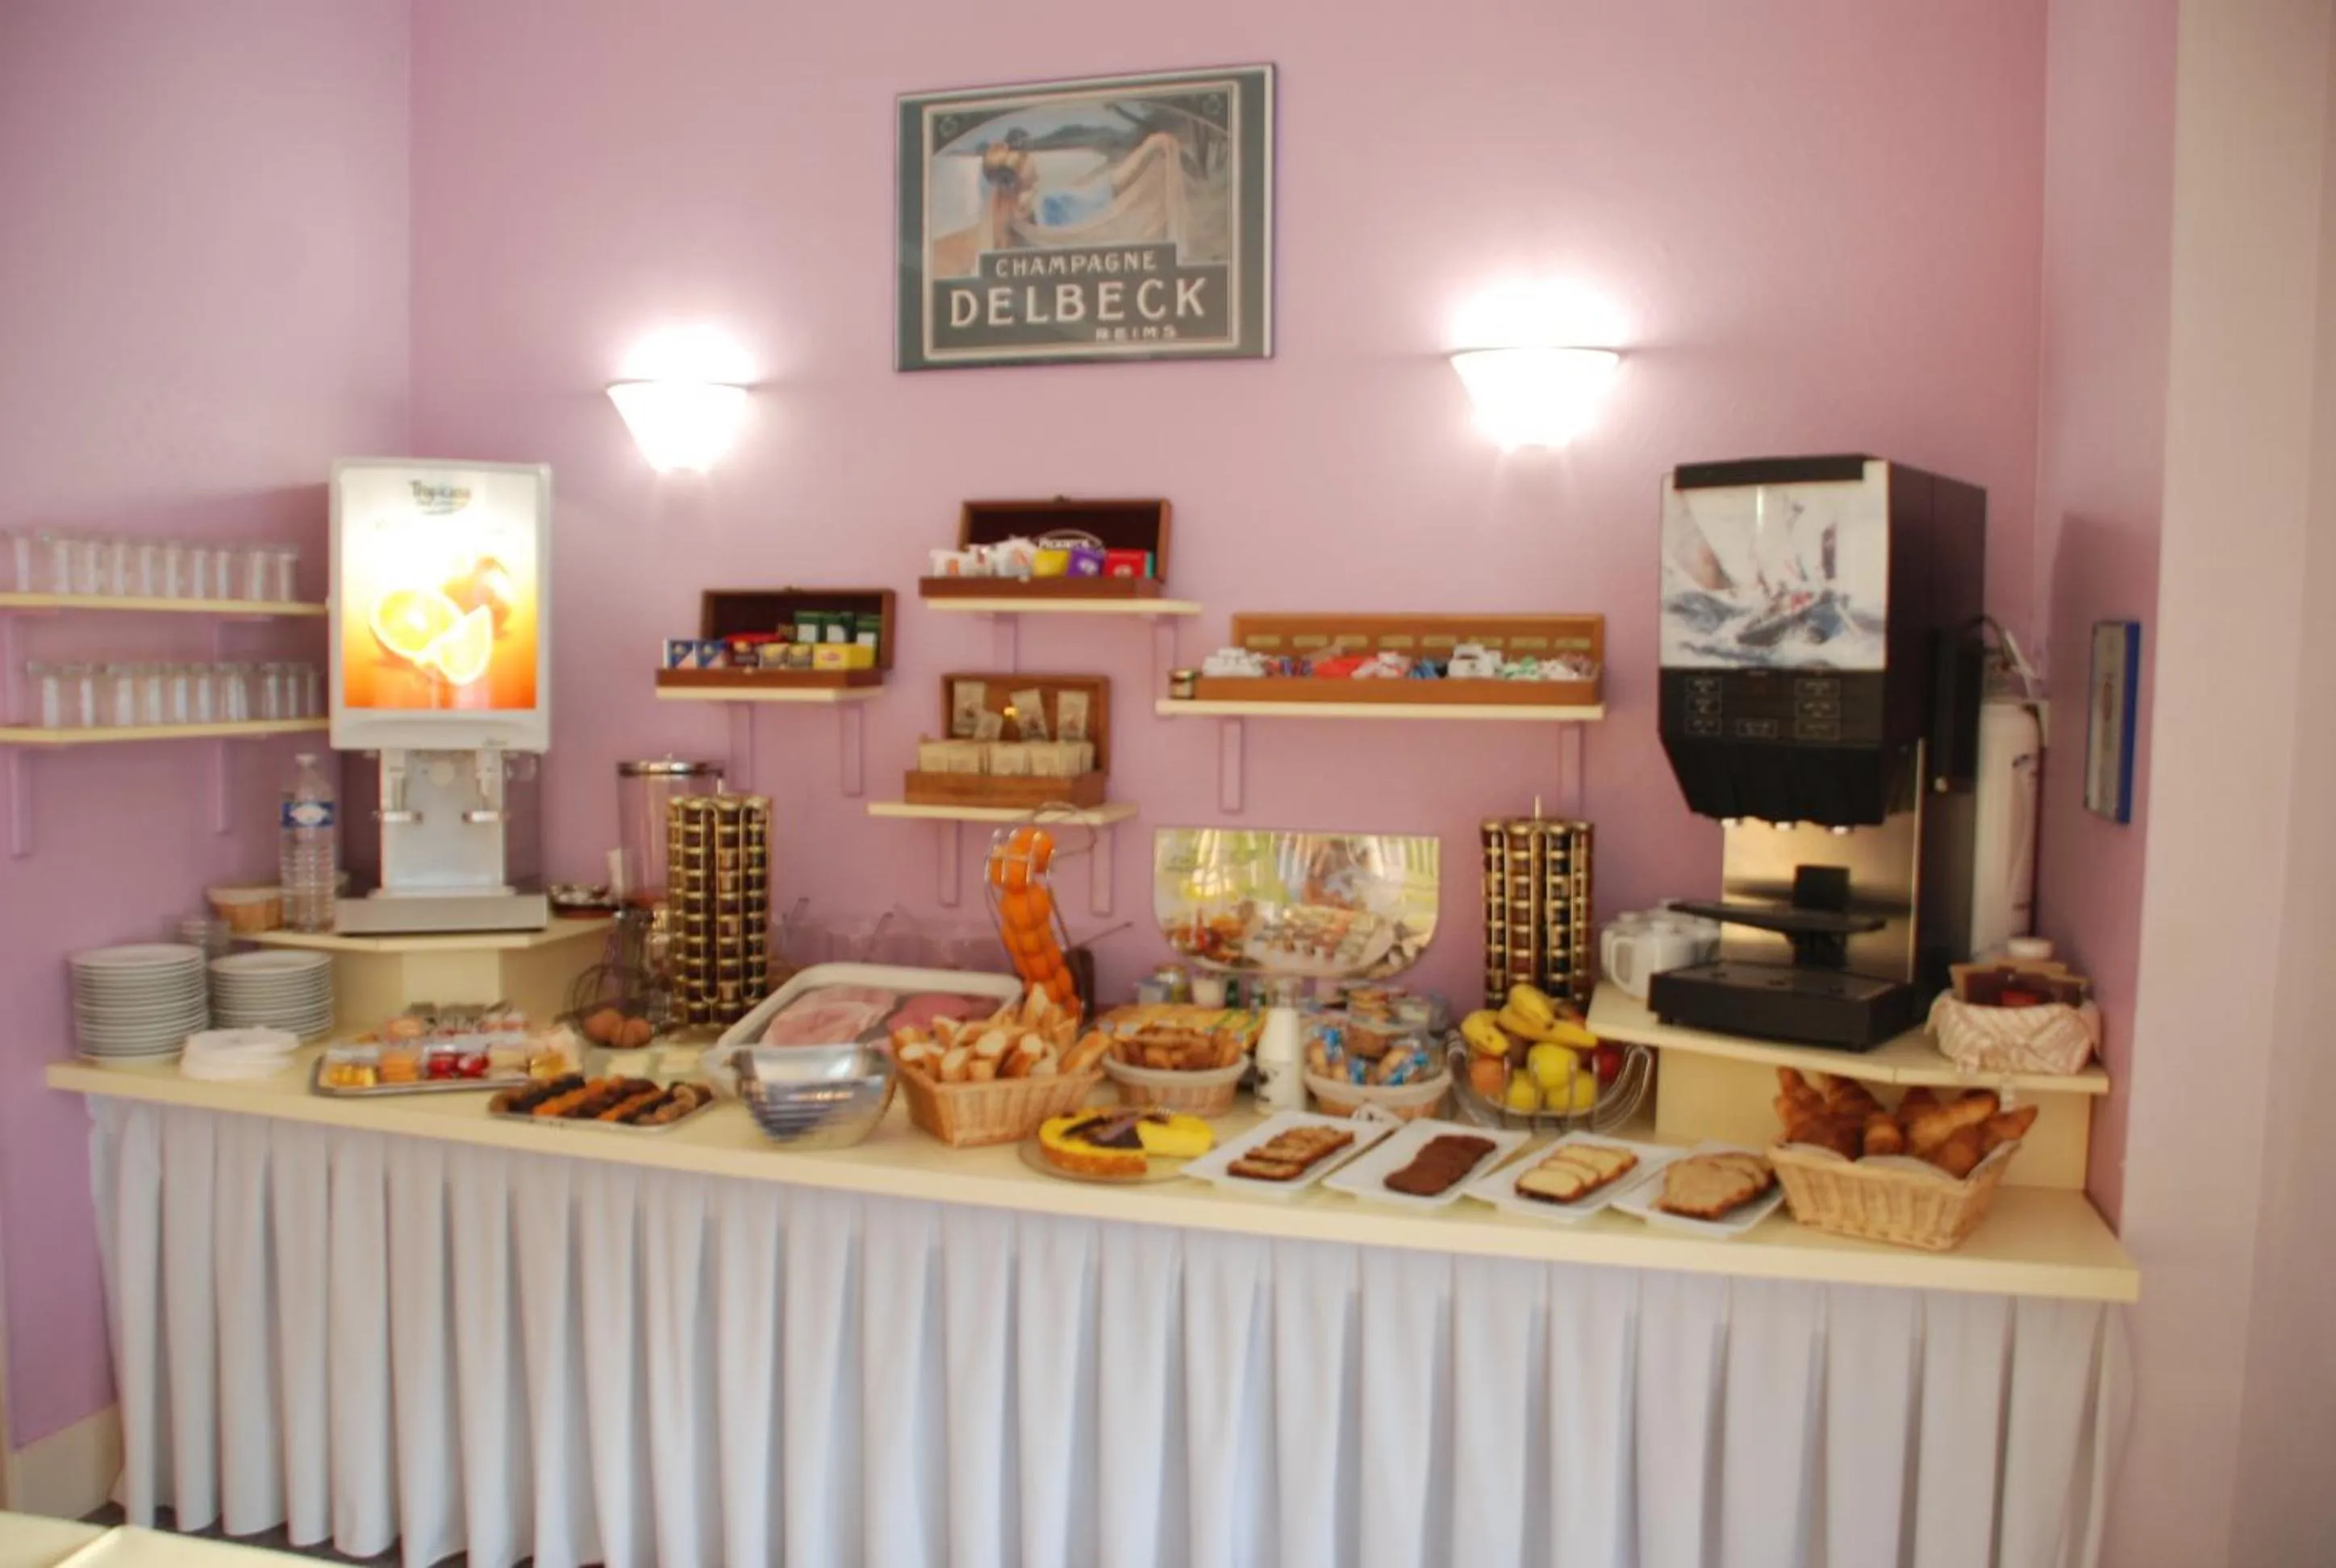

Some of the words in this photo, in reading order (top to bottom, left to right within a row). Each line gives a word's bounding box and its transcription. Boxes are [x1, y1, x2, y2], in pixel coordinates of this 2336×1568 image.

[995, 251, 1156, 277] CHAMPAGNE
[950, 277, 1206, 327] DELBECK
[1095, 324, 1178, 341] REIMS
